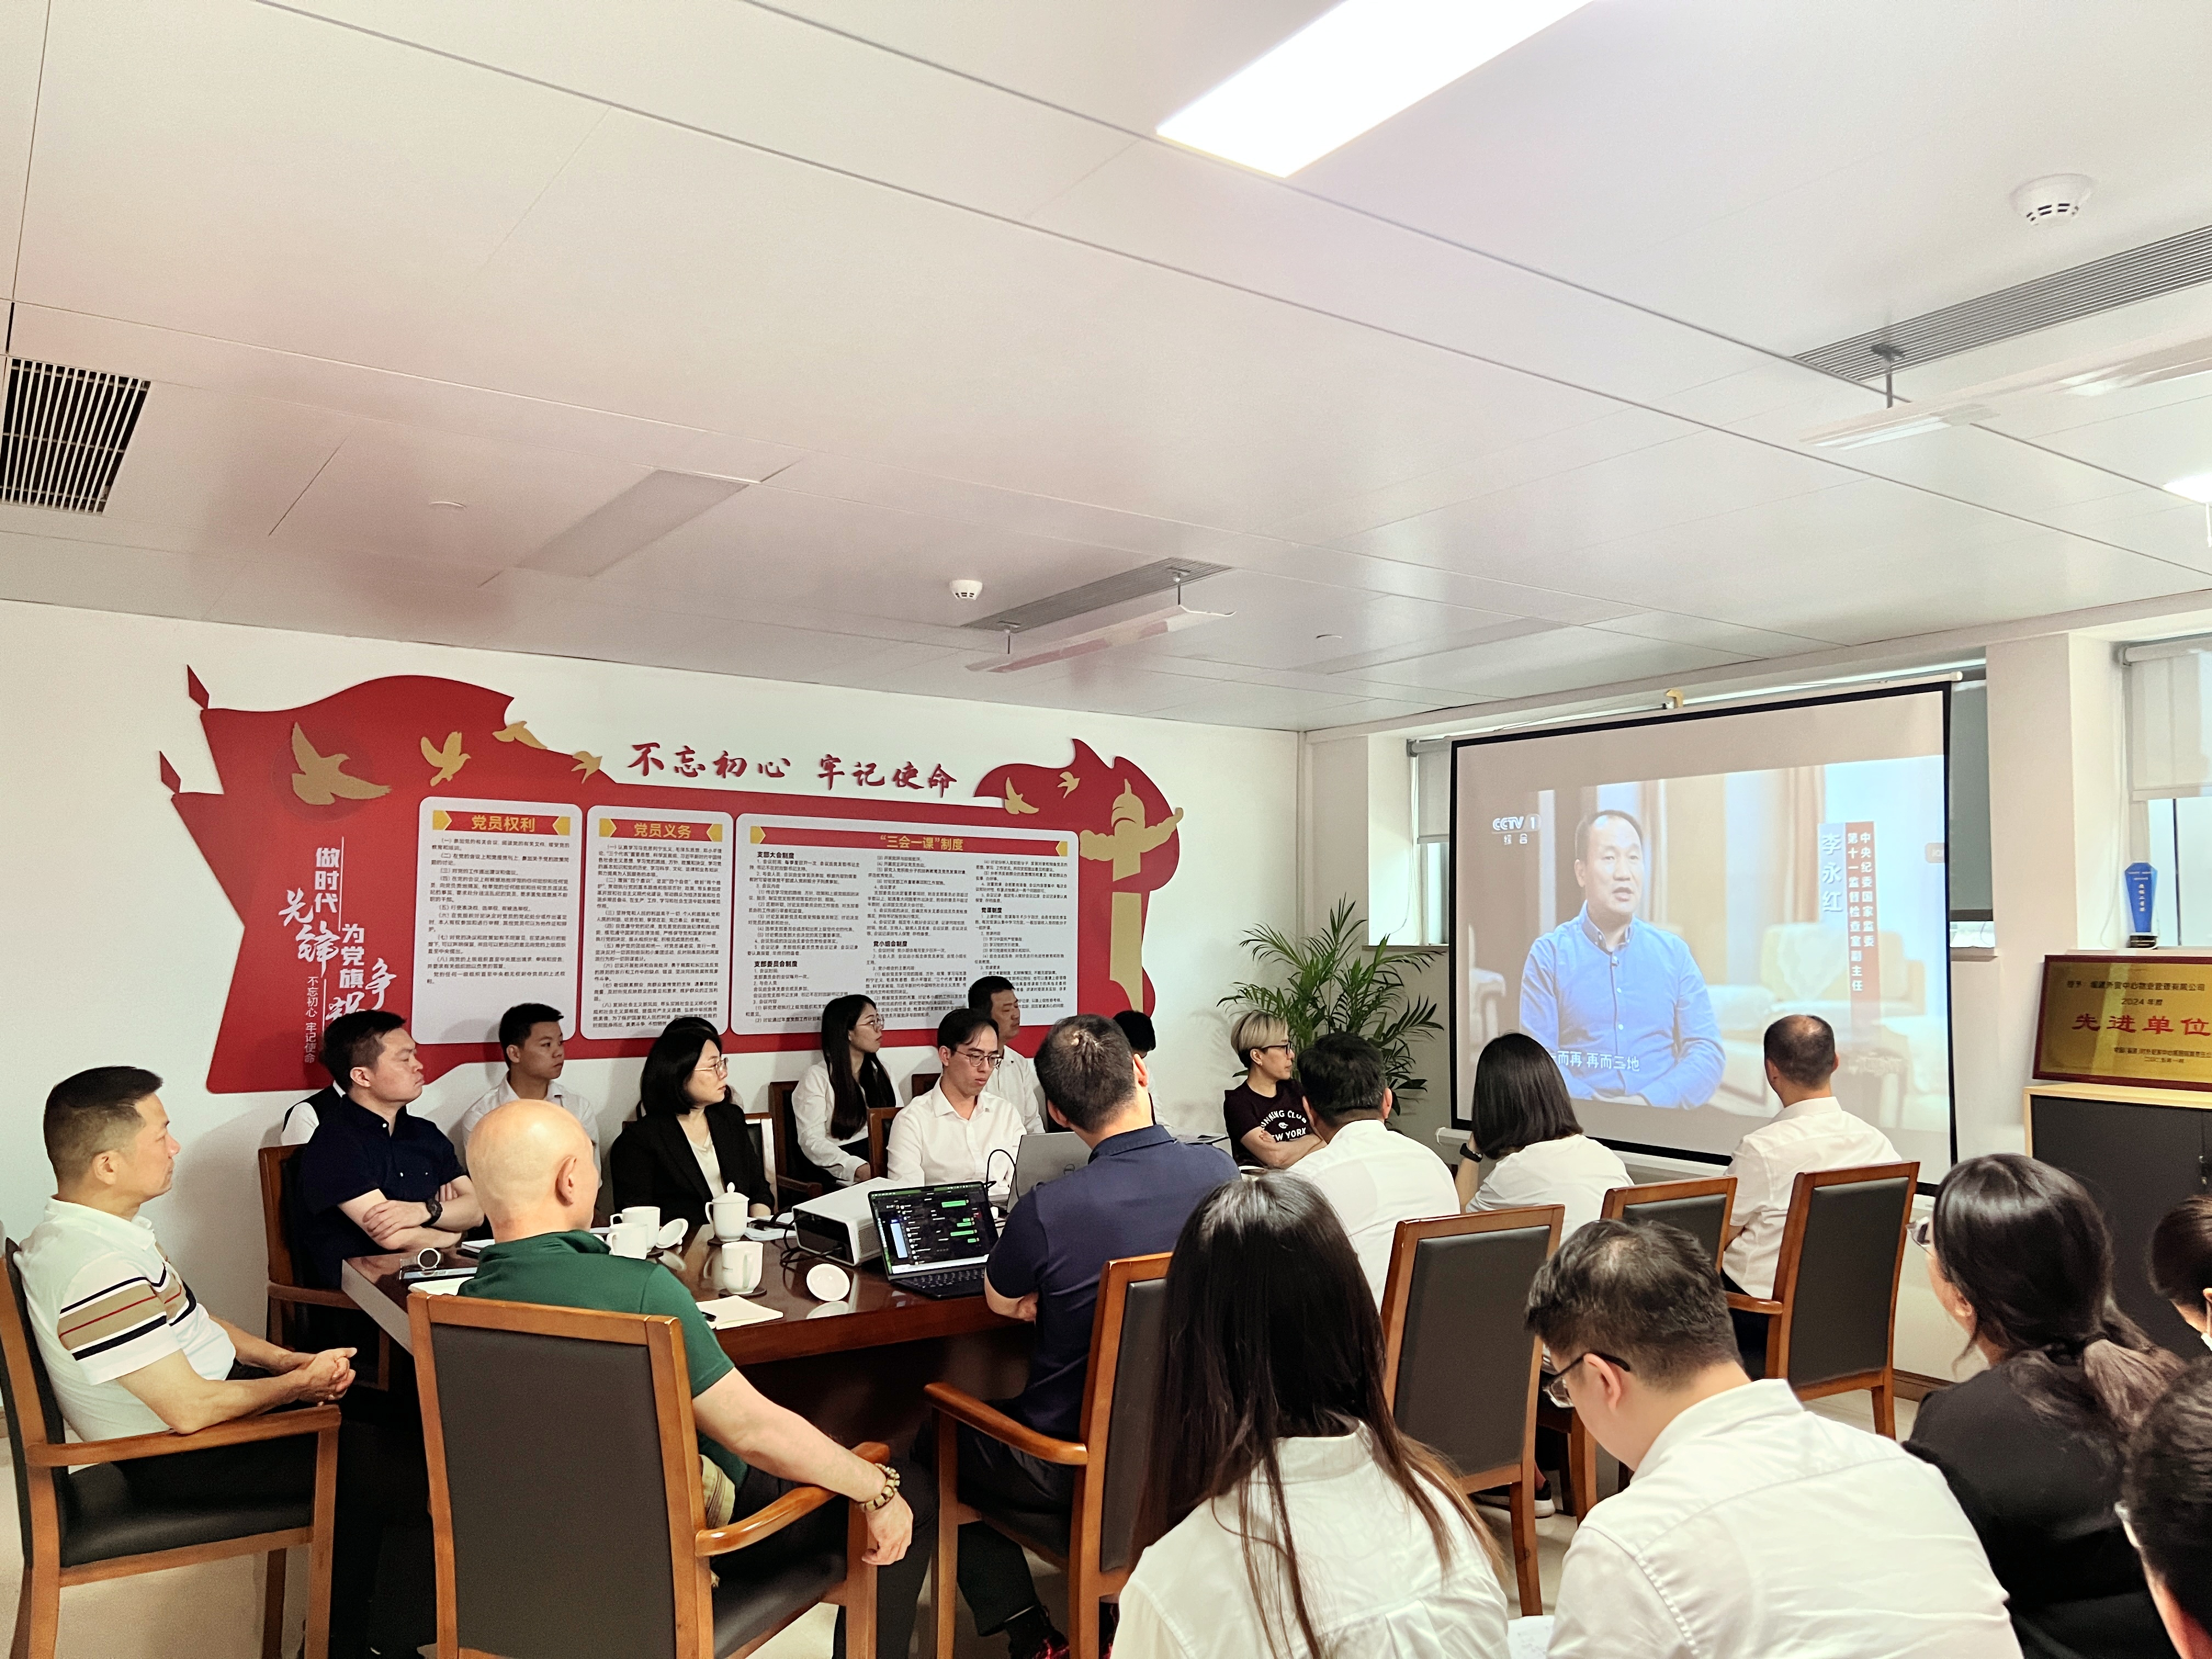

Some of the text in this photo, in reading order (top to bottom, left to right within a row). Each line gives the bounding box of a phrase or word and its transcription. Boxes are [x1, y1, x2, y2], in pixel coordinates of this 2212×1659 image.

[628, 741, 957, 798] 不忘初心 牢记使命
[472, 815, 535, 832] 党员权利
[634, 822, 691, 839] 党员义务
[1493, 816, 1535, 831] CCTV 1
[880, 834, 963, 851] “三会一课”制度
[315, 847, 340, 913] 做时代
[1822, 833, 1843, 912] 李永红
[340, 923, 365, 989] 为党旗
[304, 976, 319, 1064] 不忘初心 牢记使命
[2072, 1013, 2211, 1036] 先进单位
[1587, 1052, 1640, 1071] 再而三地
[1261, 1110, 1307, 1130] UNNING CLUB
[1285, 1127, 1306, 1139] YORK
